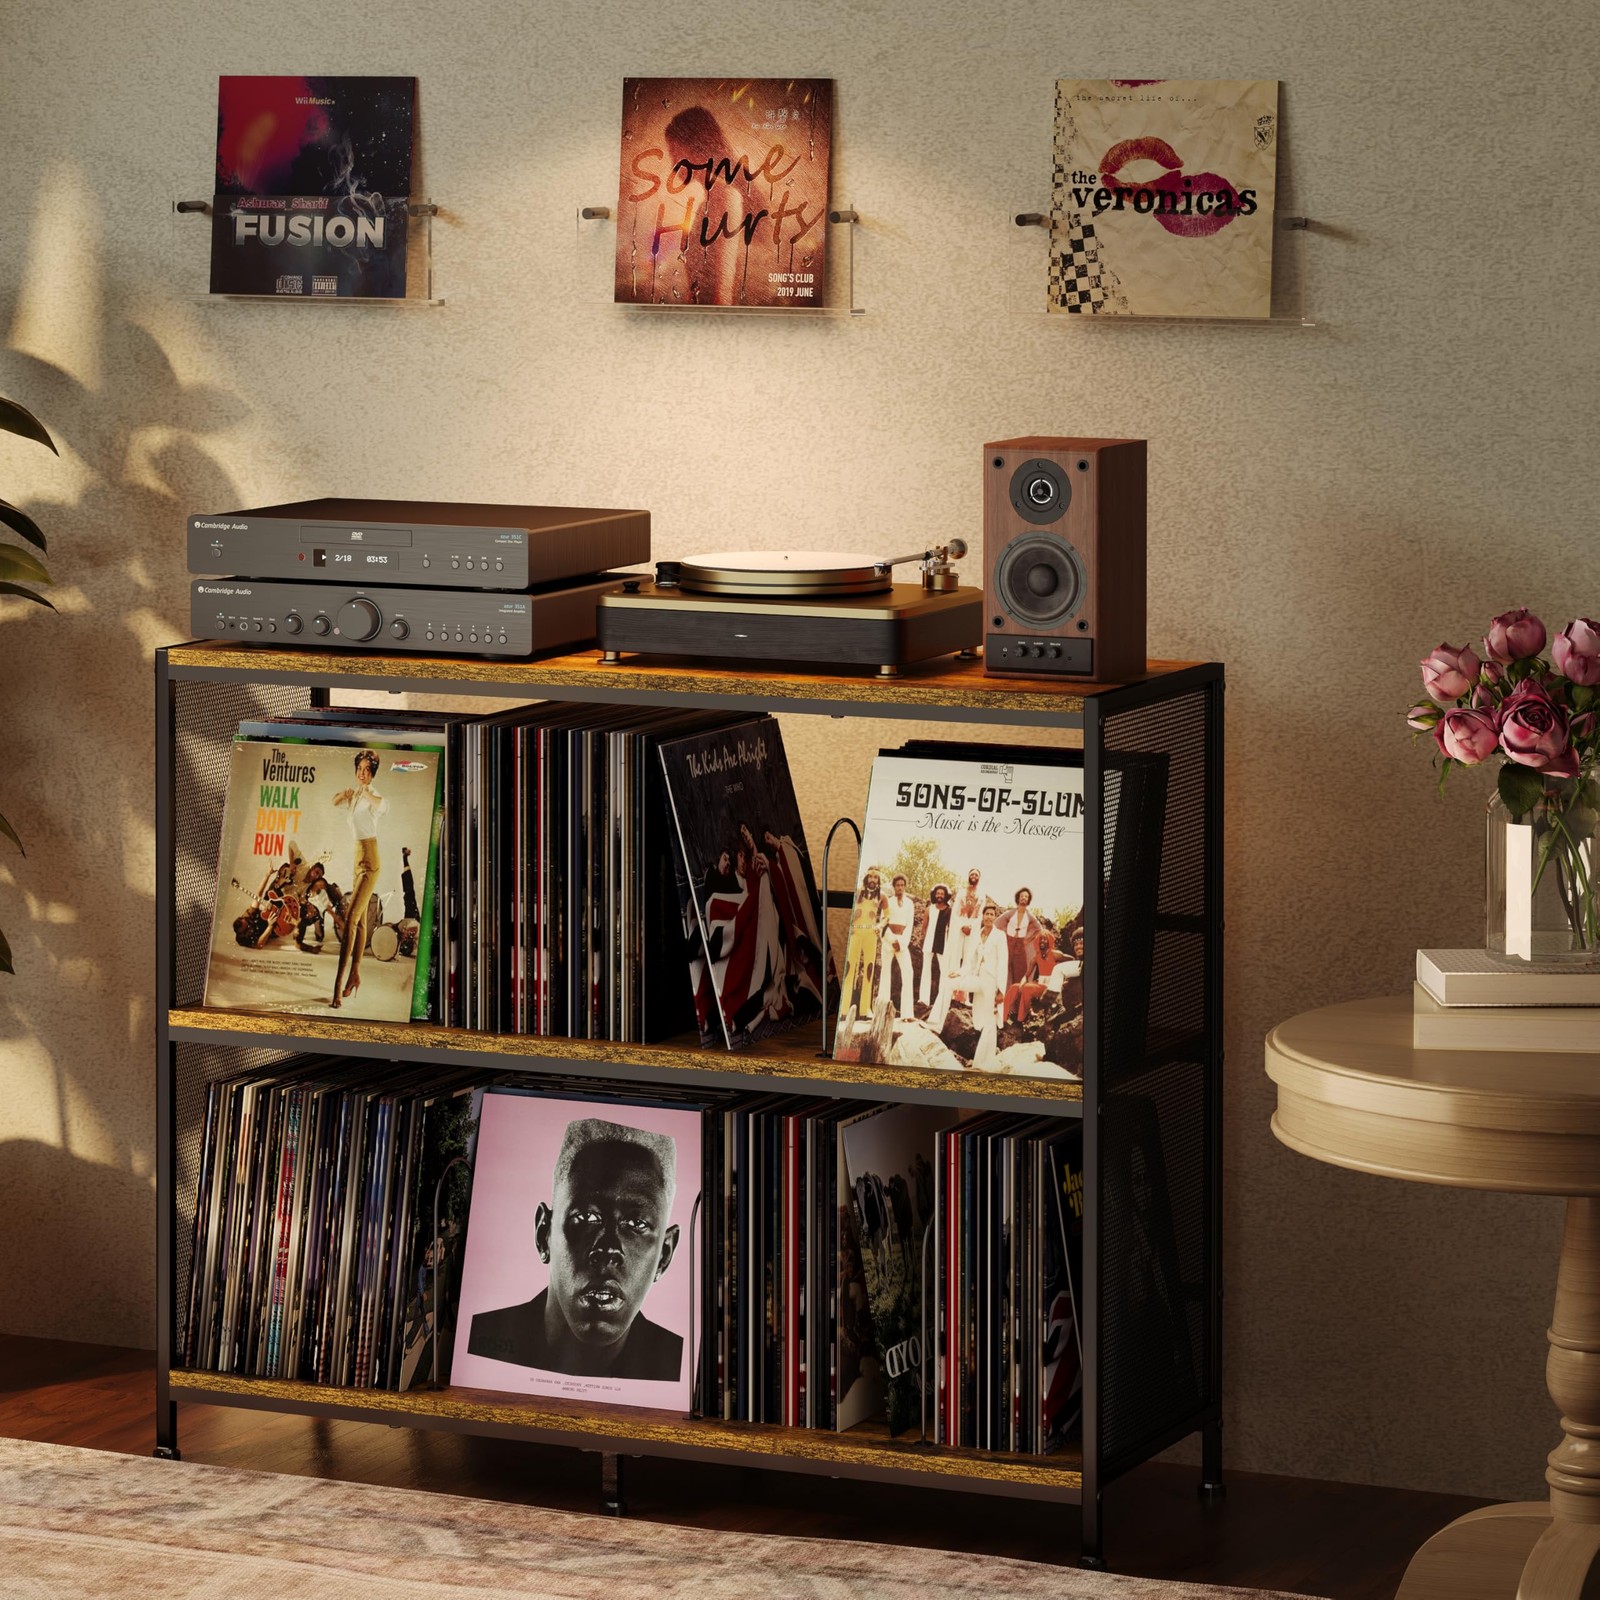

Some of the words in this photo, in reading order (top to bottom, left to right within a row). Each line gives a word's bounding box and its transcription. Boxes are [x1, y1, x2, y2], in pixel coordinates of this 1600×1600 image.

[629, 144, 801, 202] Some
[1071, 170, 1097, 185] the
[1072, 179, 1258, 217] veronicas
[235, 214, 385, 248] FUSION
[652, 190, 825, 255] Hurts
[768, 272, 794, 283] SONG'S
[795, 273, 814, 284] CLUB
[777, 287, 794, 297] 2019
[795, 287, 814, 297] JUNE
[200, 521, 231, 531] Cambridge
[334, 554, 352, 562] 2/18
[366, 555, 388, 564] 03:53
[204, 586, 234, 596] Cambridge
[235, 588, 252, 596] Audio
[272, 748, 286, 763] The
[686, 753, 703, 778] The
[701, 748, 724, 774] Kids
[723, 745, 738, 771] Are
[263, 758, 316, 783] Ventures
[260, 785, 300, 809] WALK
[256, 808, 302, 833] DON'T
[915, 812, 964, 831] Music
[967, 815, 977, 832] is
[981, 816, 1001, 833] the
[1003, 818, 1066, 840] Message
[253, 832, 285, 857] RUN
